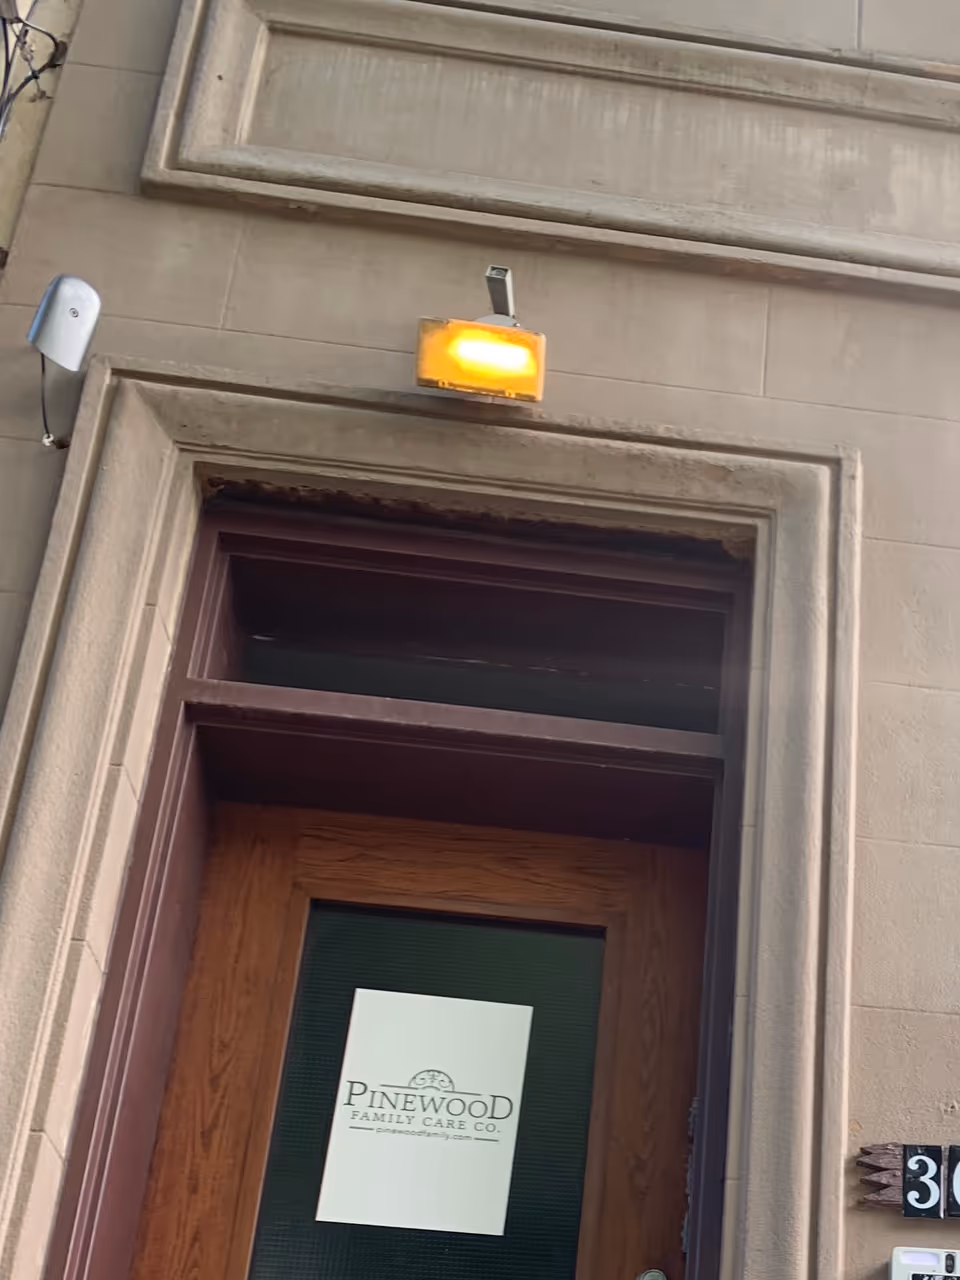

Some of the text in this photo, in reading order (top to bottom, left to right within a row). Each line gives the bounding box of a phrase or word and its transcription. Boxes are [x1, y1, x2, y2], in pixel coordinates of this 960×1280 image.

[343, 1080, 513, 1120] PINEWOOD
[350, 1110, 501, 1133] FAMILY CARE CO.
[375, 1127, 473, 1141] pinewoodfamily.com
